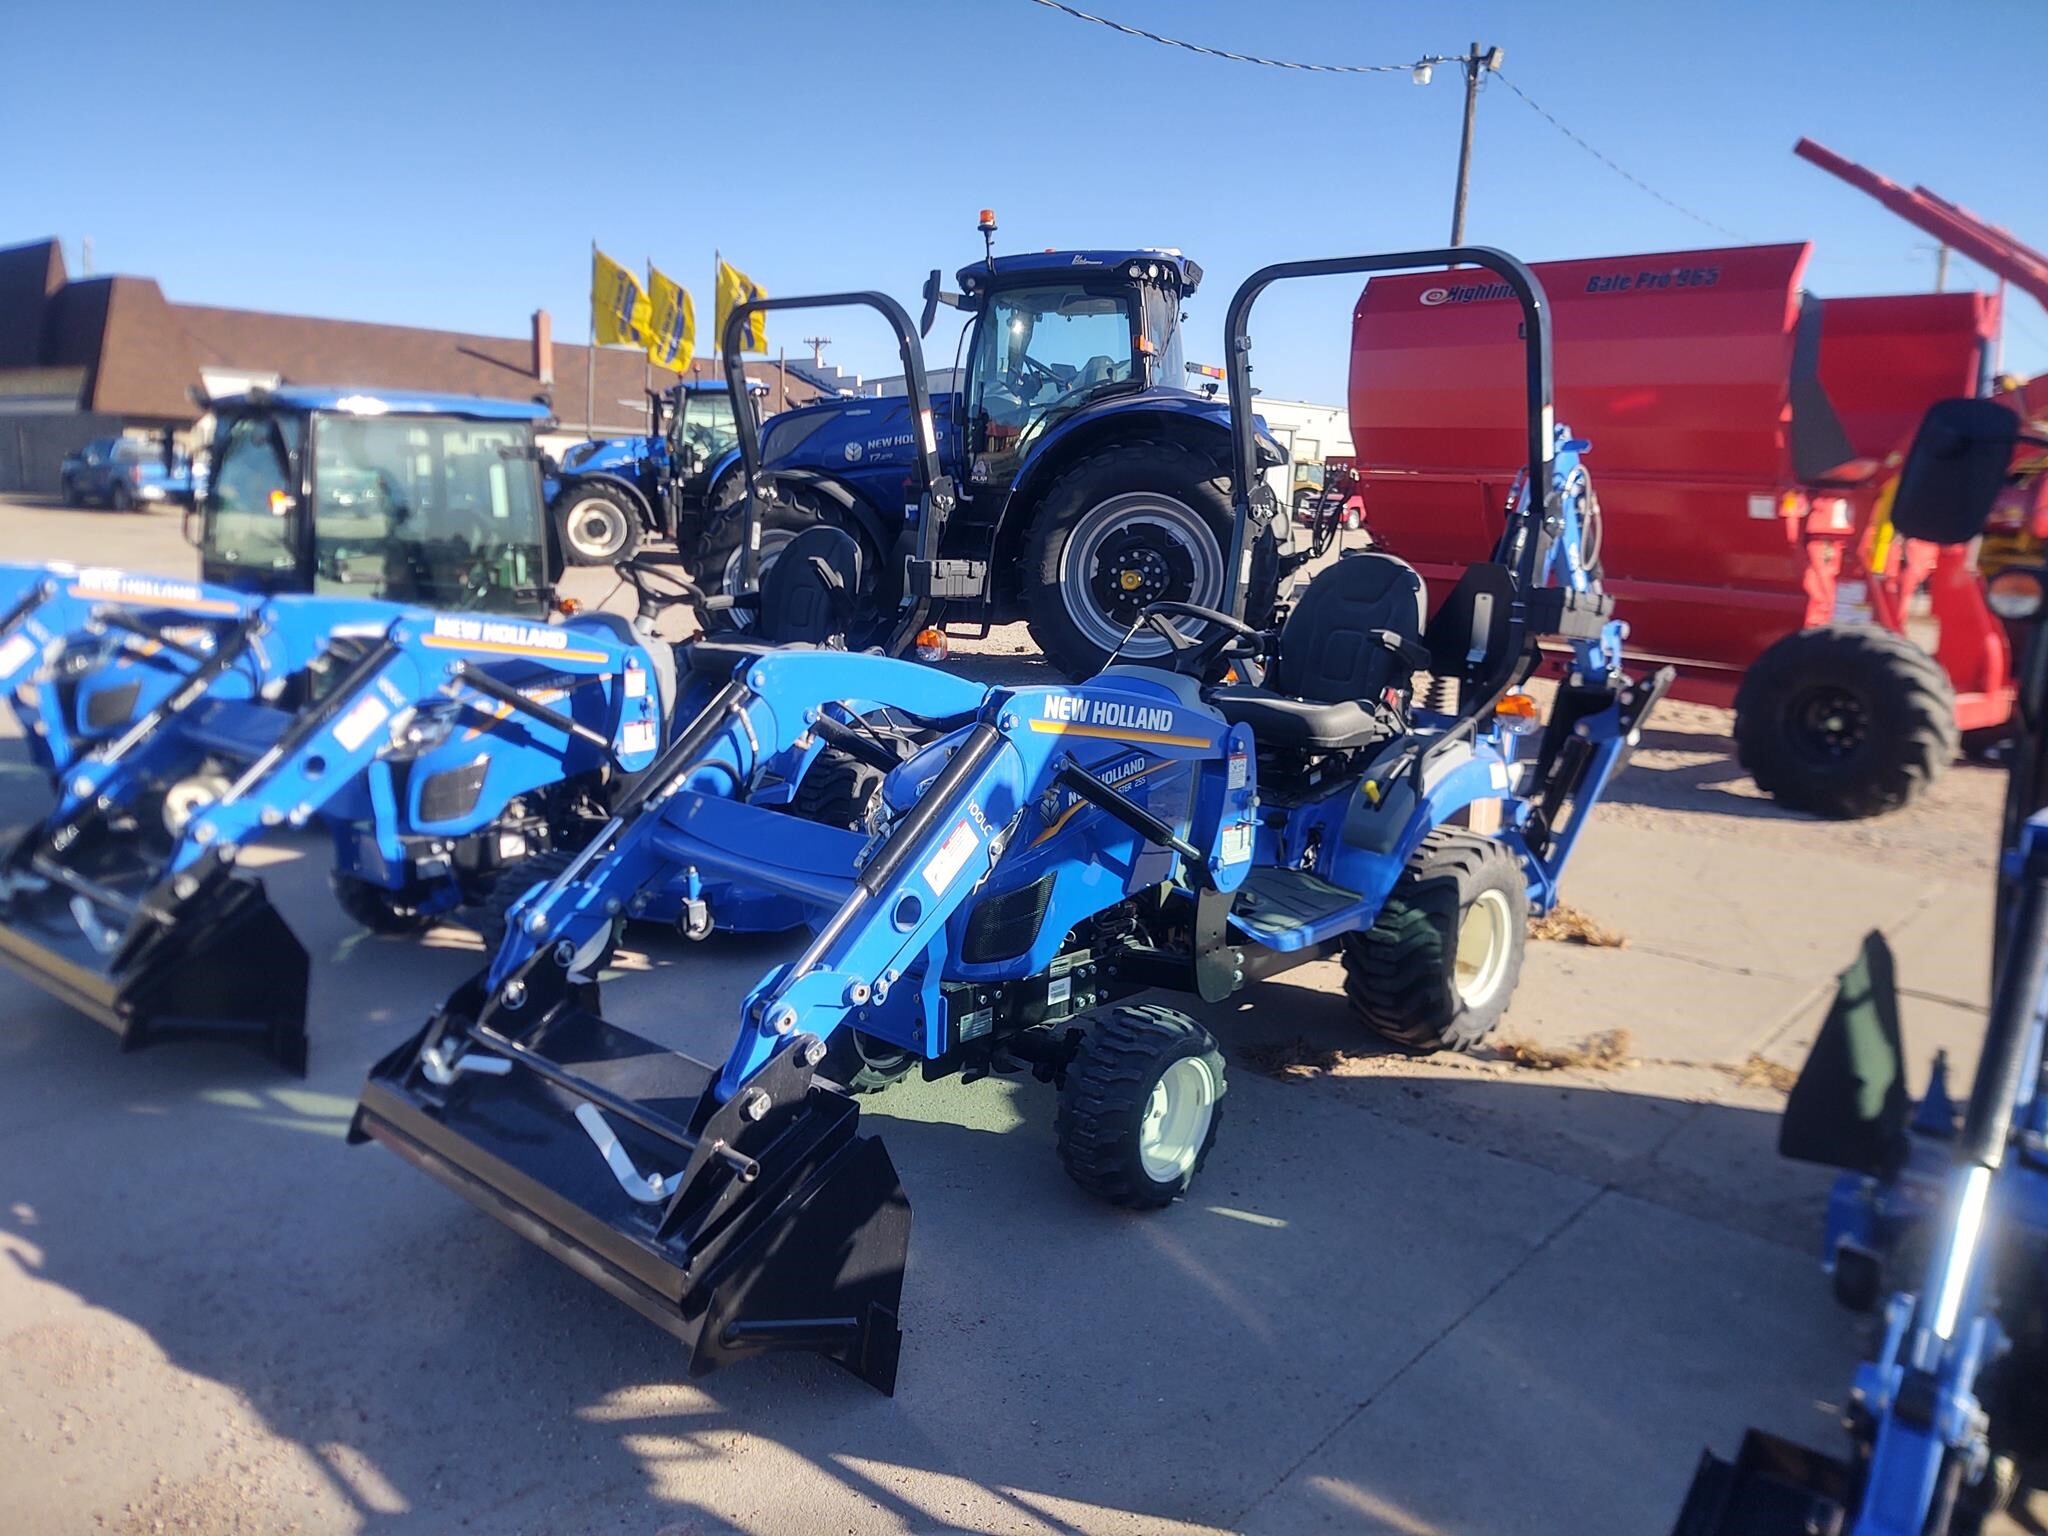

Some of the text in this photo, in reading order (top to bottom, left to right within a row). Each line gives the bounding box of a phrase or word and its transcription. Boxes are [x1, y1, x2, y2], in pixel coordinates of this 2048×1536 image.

[1585, 274, 1632, 294] Bale
[1635, 271, 1671, 289] Pro
[867, 431, 944, 450] NEW HOLD
[434, 617, 568, 650] NEW HOLLAND
[1043, 694, 1174, 732] NEW HOLLAND
[967, 798, 994, 838] 100LC
